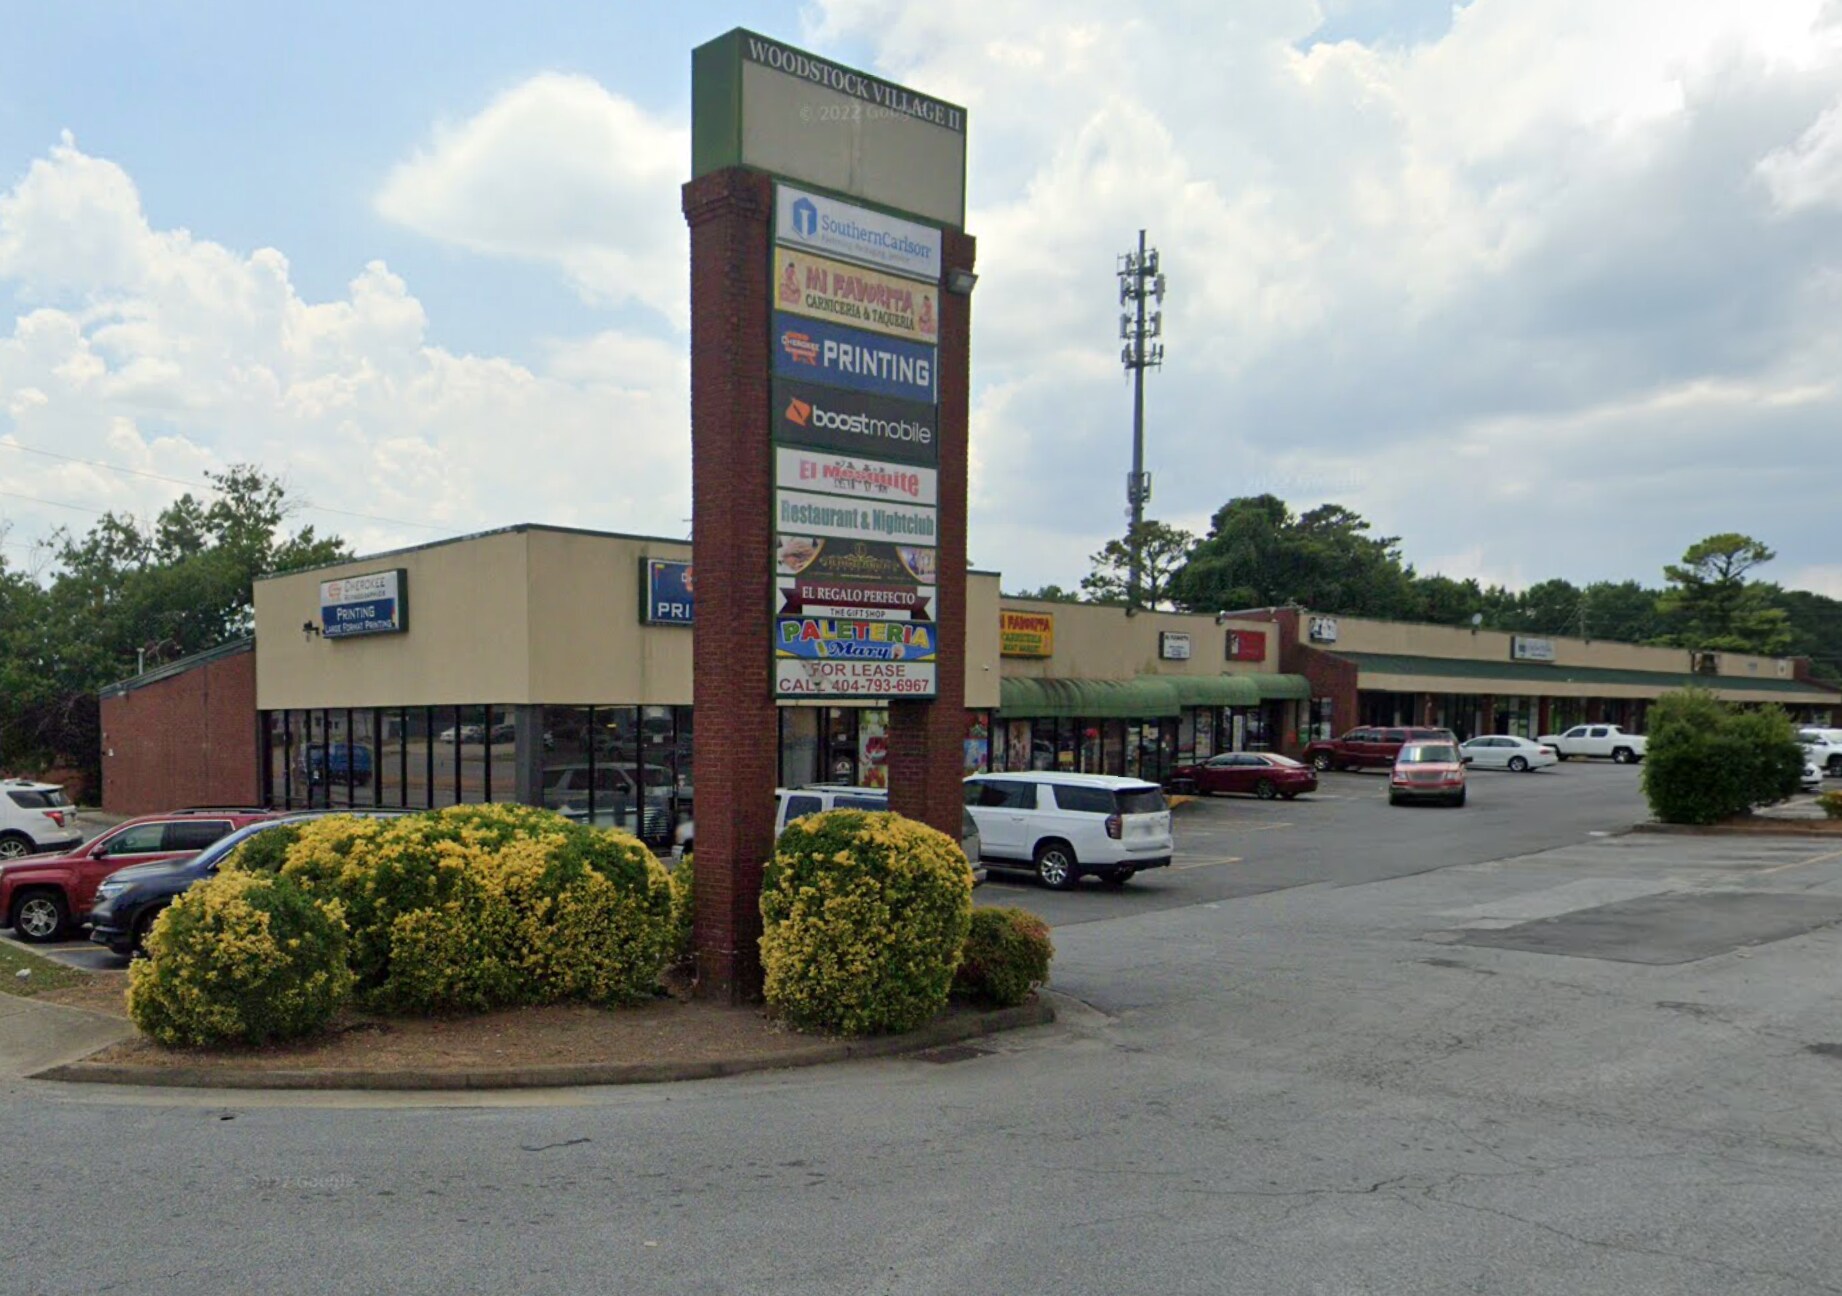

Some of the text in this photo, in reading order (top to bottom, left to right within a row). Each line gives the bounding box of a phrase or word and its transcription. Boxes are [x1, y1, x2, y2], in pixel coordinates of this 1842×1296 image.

[748, 38, 961, 130] WOODSTOCK VILLAGE II
[821, 214, 932, 259] SouthernCarlson
[805, 266, 915, 314] MI FAVORITA
[805, 293, 915, 331] CARNICERIA & TAQUERIA
[823, 339, 930, 387] PRINTING
[812, 405, 932, 443] boostmobile
[799, 458, 817, 481] El
[781, 500, 934, 536] Restaurant & Nightclub
[802, 586, 916, 604] EL REGALO PERFECTO
[337, 606, 375, 621] PRINTING
[658, 602, 690, 618] PRI
[830, 608, 886, 618] THE GIFT SHOP
[780, 619, 930, 649] PALETERIA
[829, 641, 890, 660] Mary
[811, 662, 906, 678] FOR LEASE
[831, 678, 930, 692] 404-793-6967
